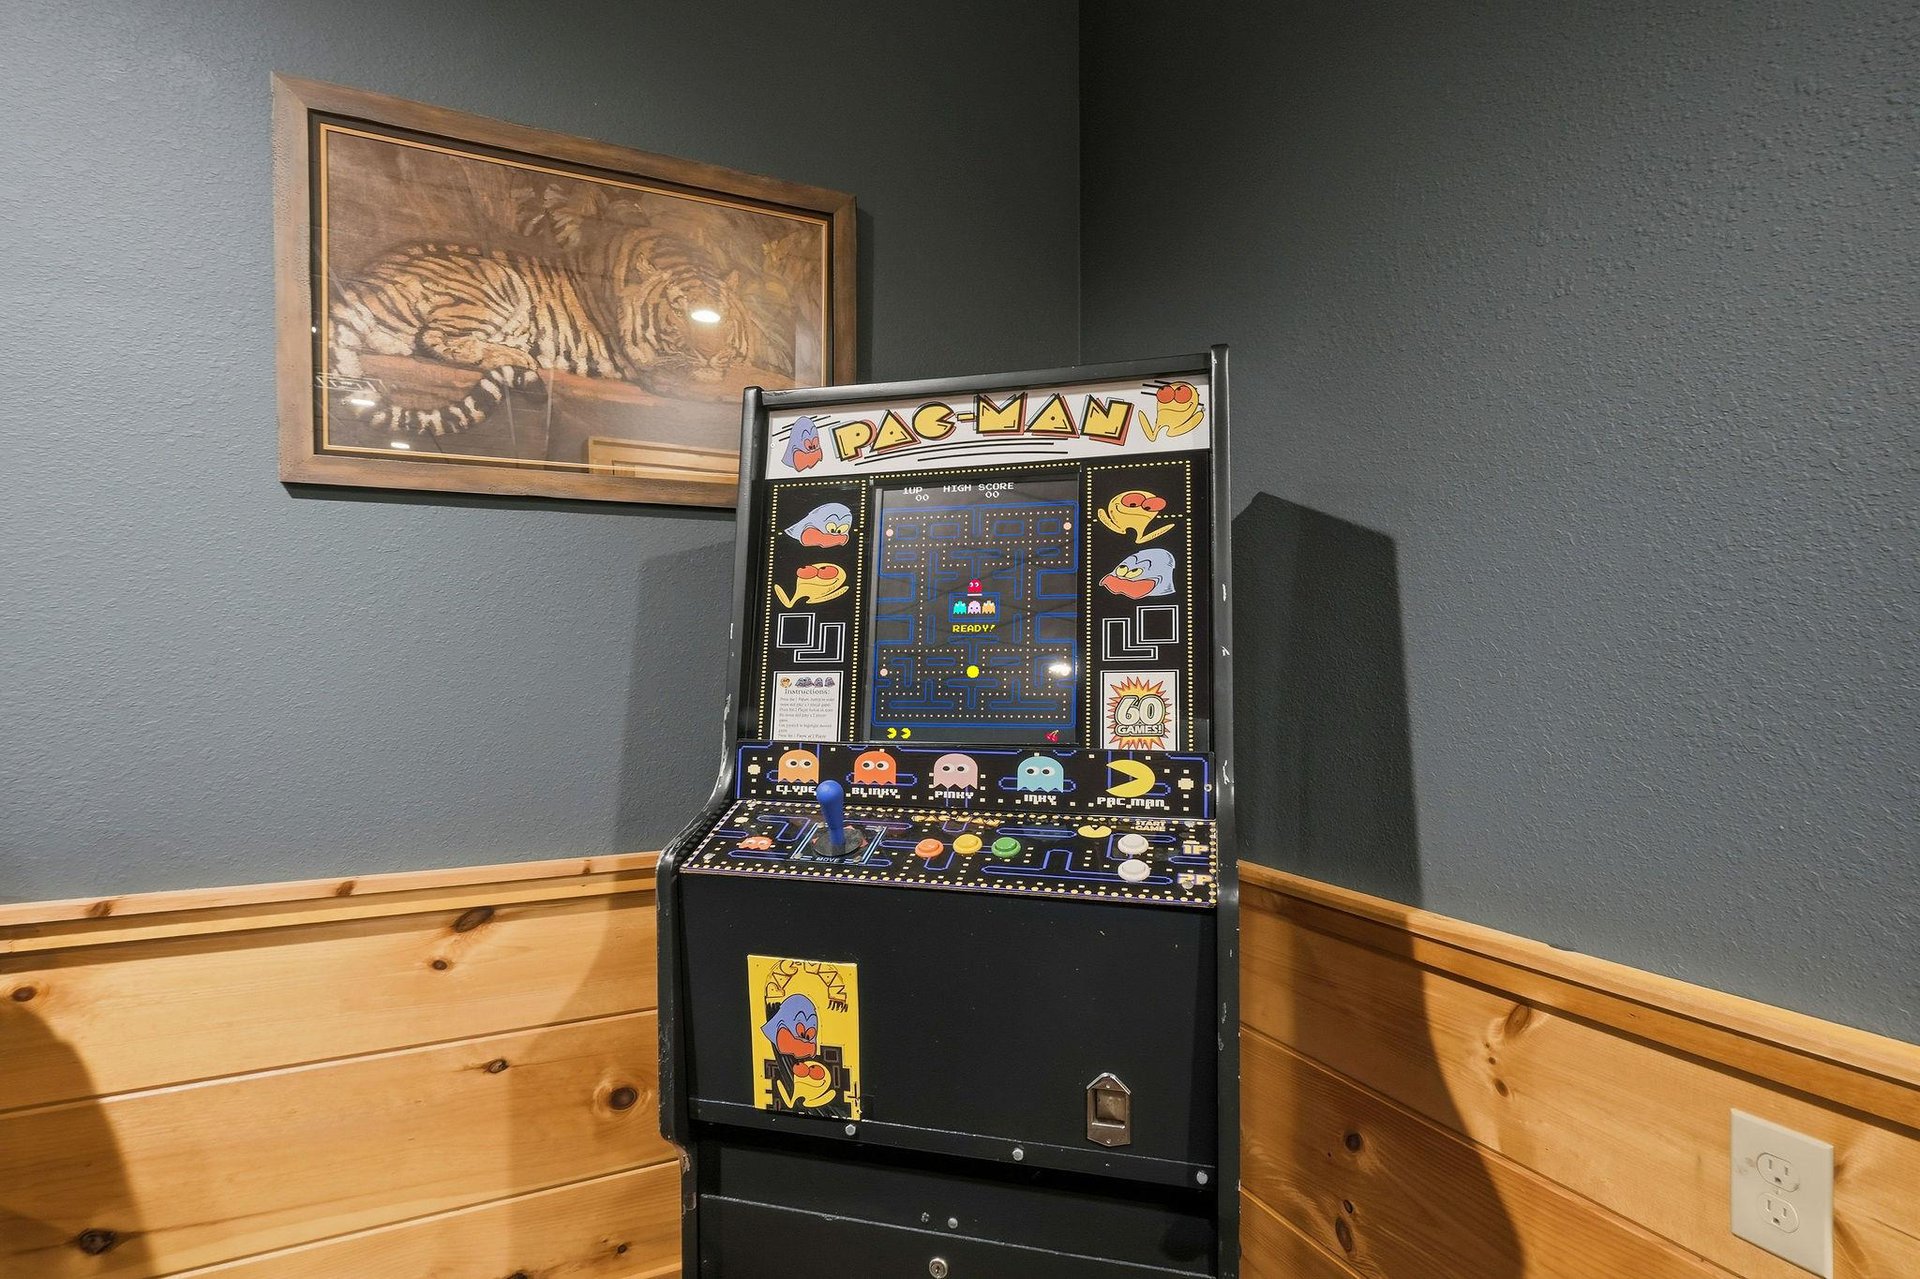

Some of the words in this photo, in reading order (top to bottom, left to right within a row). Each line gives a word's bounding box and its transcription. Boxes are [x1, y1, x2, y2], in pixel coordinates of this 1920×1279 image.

[830, 392, 1135, 462] PAC-MAN
[902, 486, 923, 495] 1UP
[943, 484, 972, 493] HIGH
[978, 482, 1015, 491] SCORE
[952, 624, 996, 633] READY!
[1115, 693, 1167, 726] 60
[1117, 725, 1163, 735] GAMES!
[1182, 840, 1210, 855] 1P
